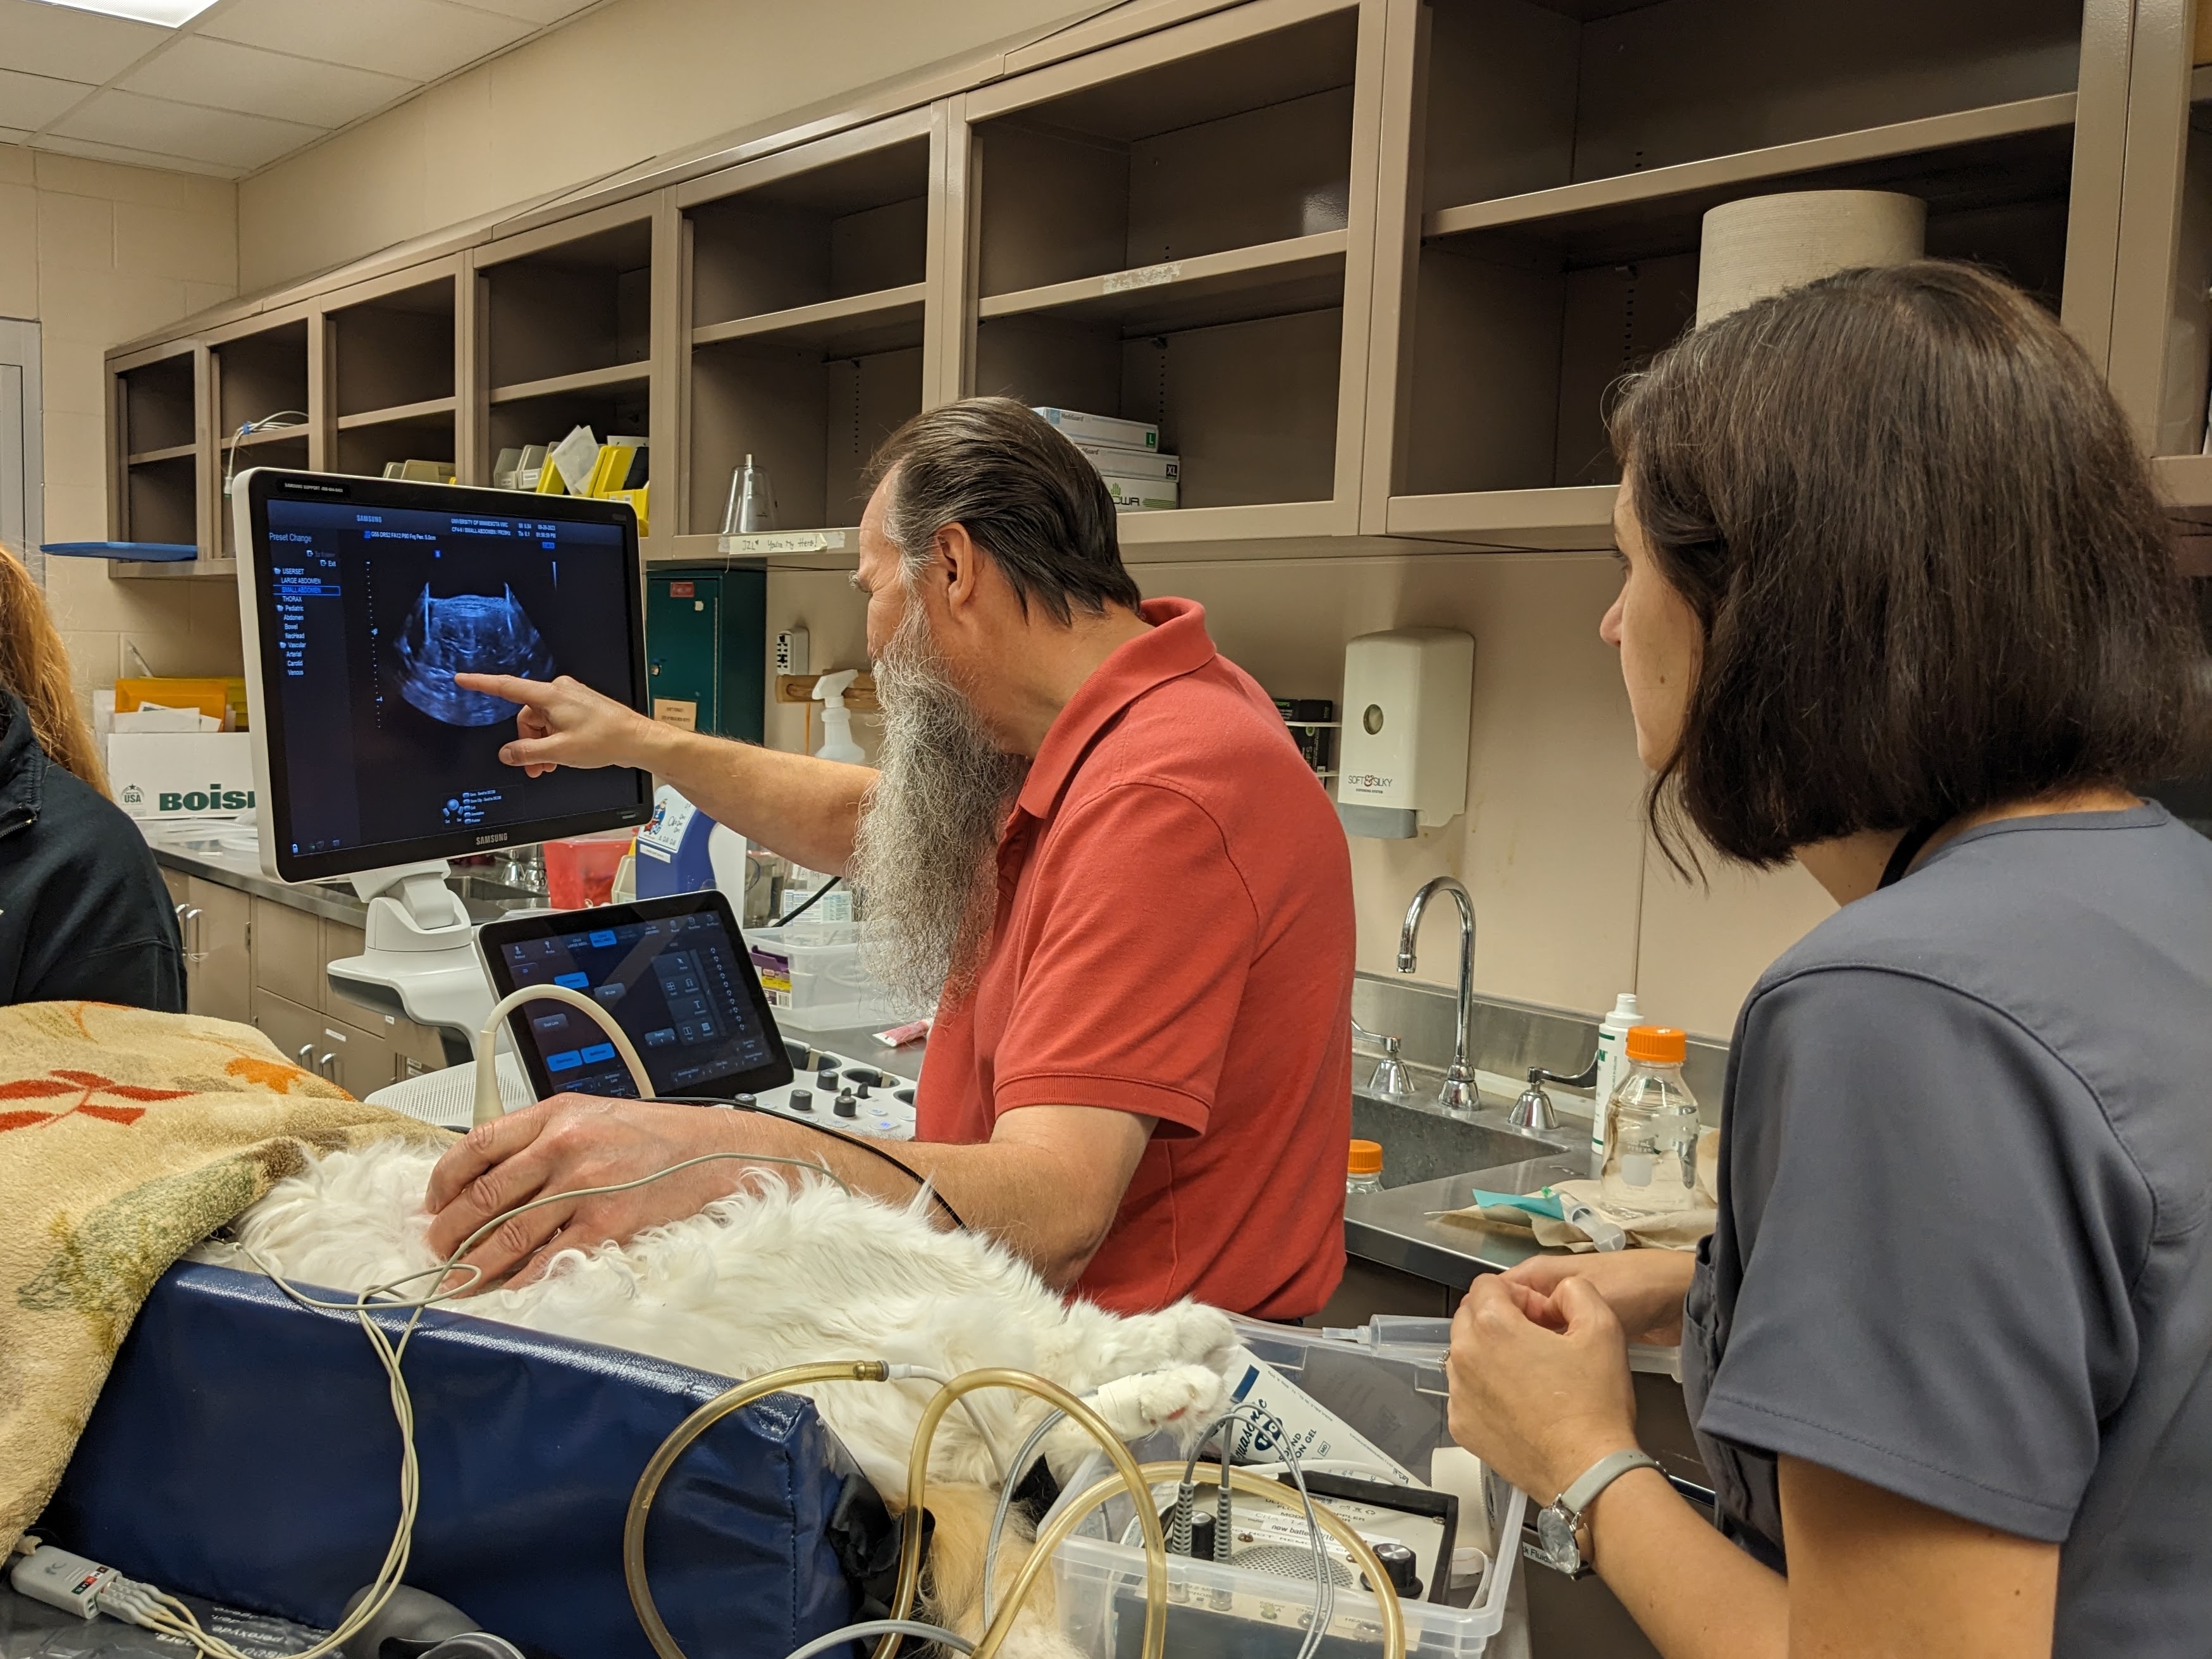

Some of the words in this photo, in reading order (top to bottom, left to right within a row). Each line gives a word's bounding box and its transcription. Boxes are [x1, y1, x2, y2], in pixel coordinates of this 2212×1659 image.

[1149, 433, 1154, 444] L
[1166, 465, 1178, 476] XL
[356, 514, 382, 523] SAMSUNG
[269, 532, 288, 541] Preset
[289, 533, 312, 544] Change
[124, 793, 142, 803] USA
[476, 832, 508, 845] SAMSUNG
[1306, 1428, 1317, 1445] GEL
[1321, 1443, 1328, 1455] MD
